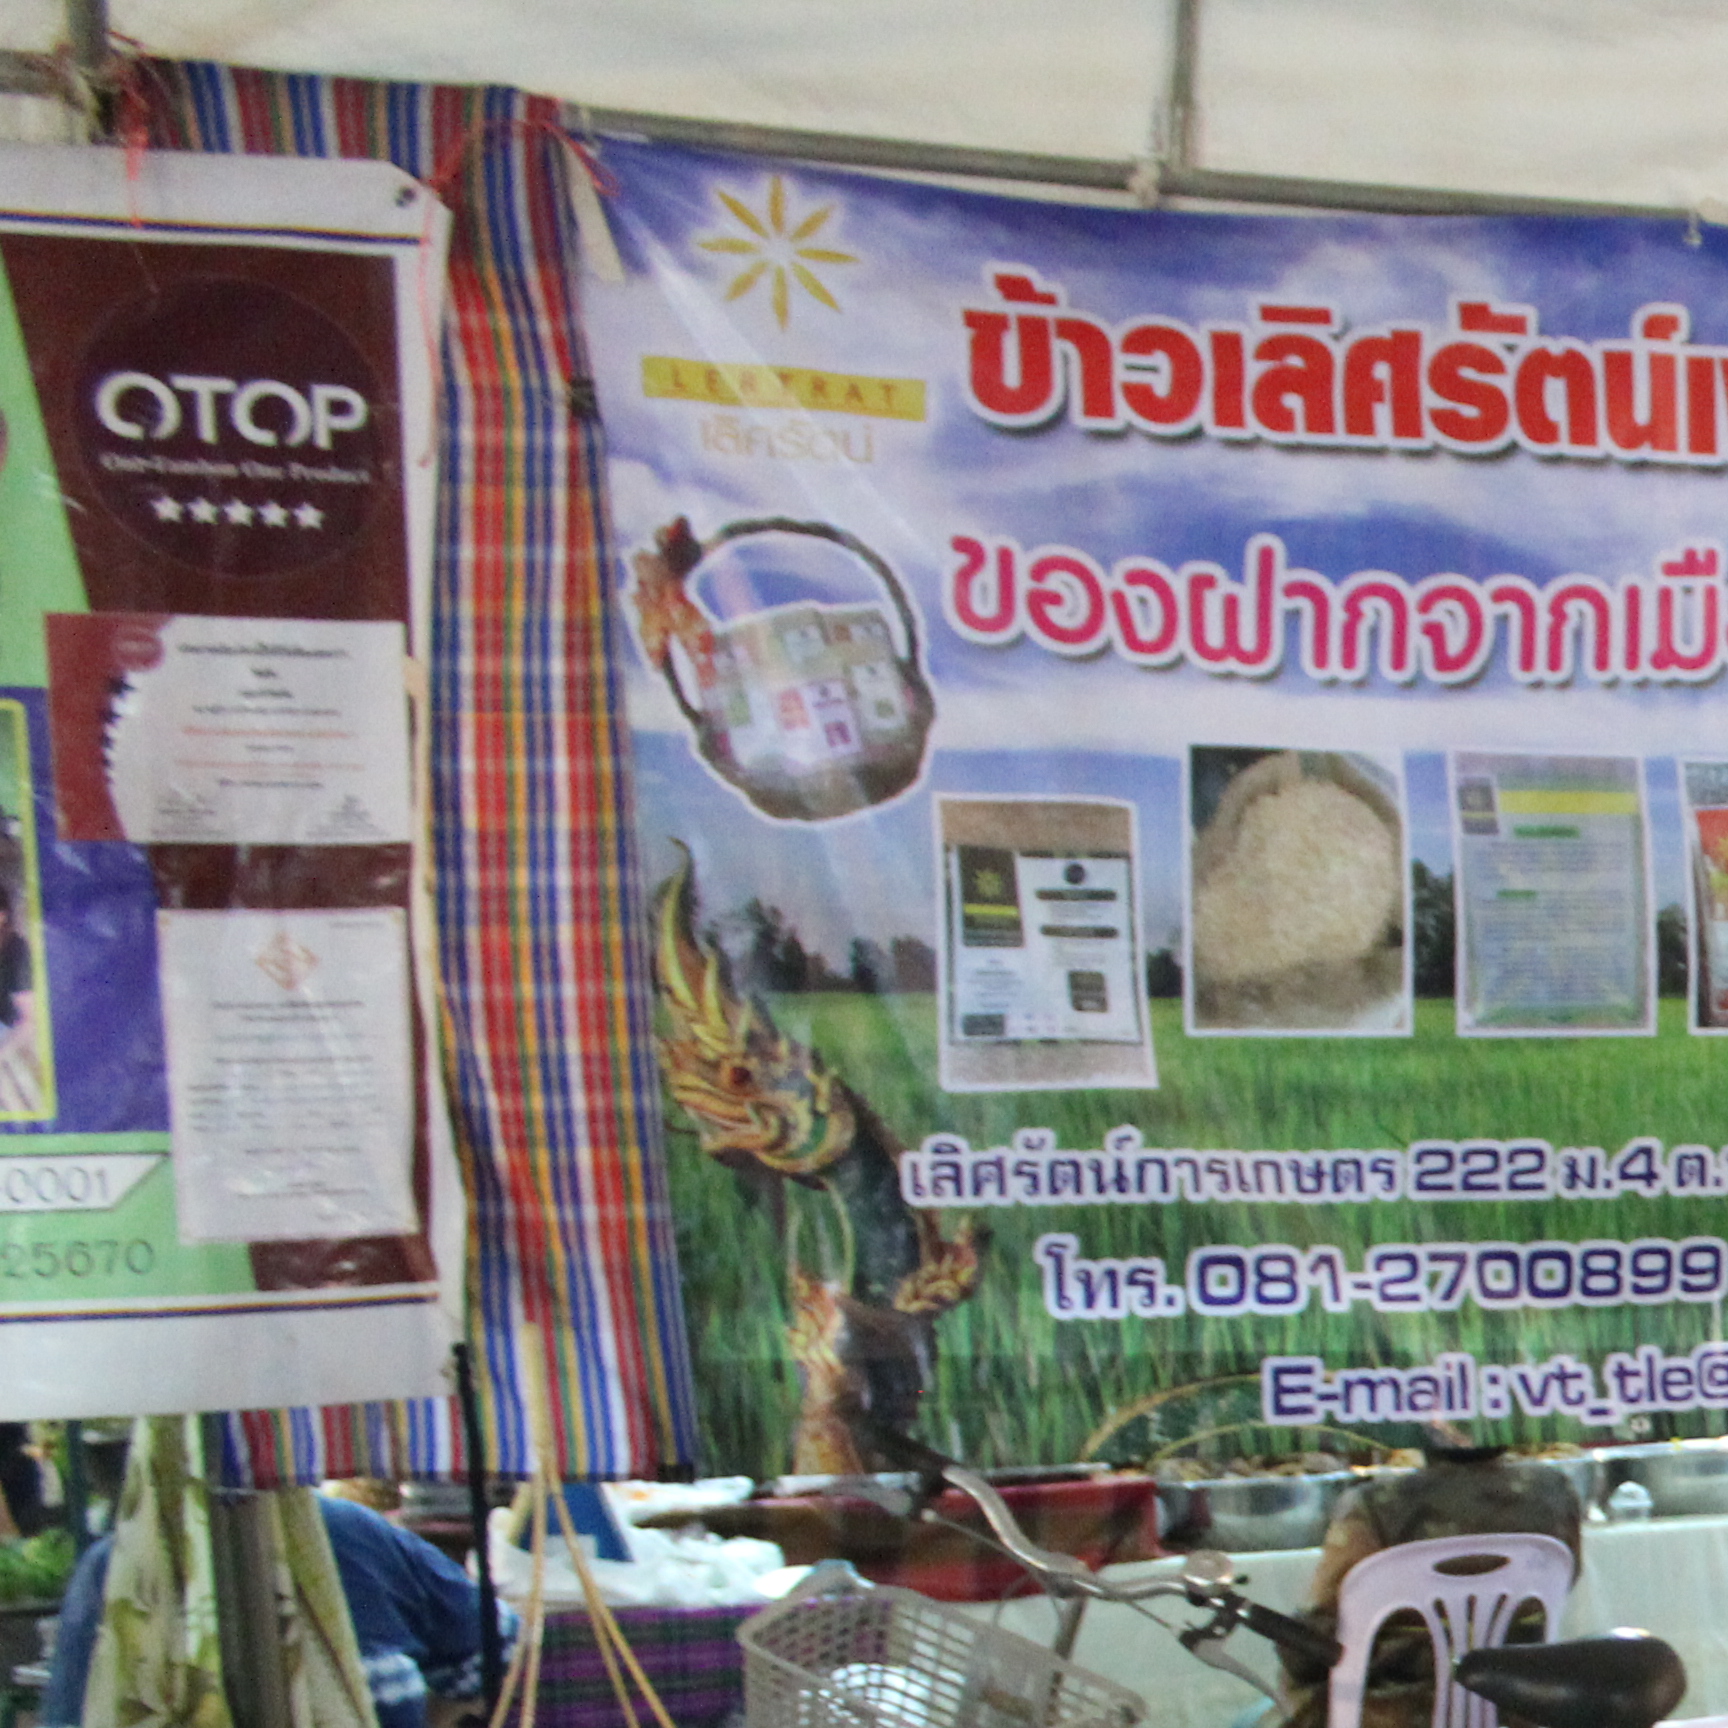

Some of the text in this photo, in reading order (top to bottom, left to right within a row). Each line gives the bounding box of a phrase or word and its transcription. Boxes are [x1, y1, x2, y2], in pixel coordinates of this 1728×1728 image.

[95, 369, 370, 451] OTOP
[907, 1130, 1397, 1199] เลิศรัตน์การเกษตร
[1411, 1145, 1549, 1195] 222
[1561, 1143, 1661, 1191] ม.4
[1041, 1241, 1182, 1312] โทร.
[1272, 1360, 1473, 1419] E-mail
